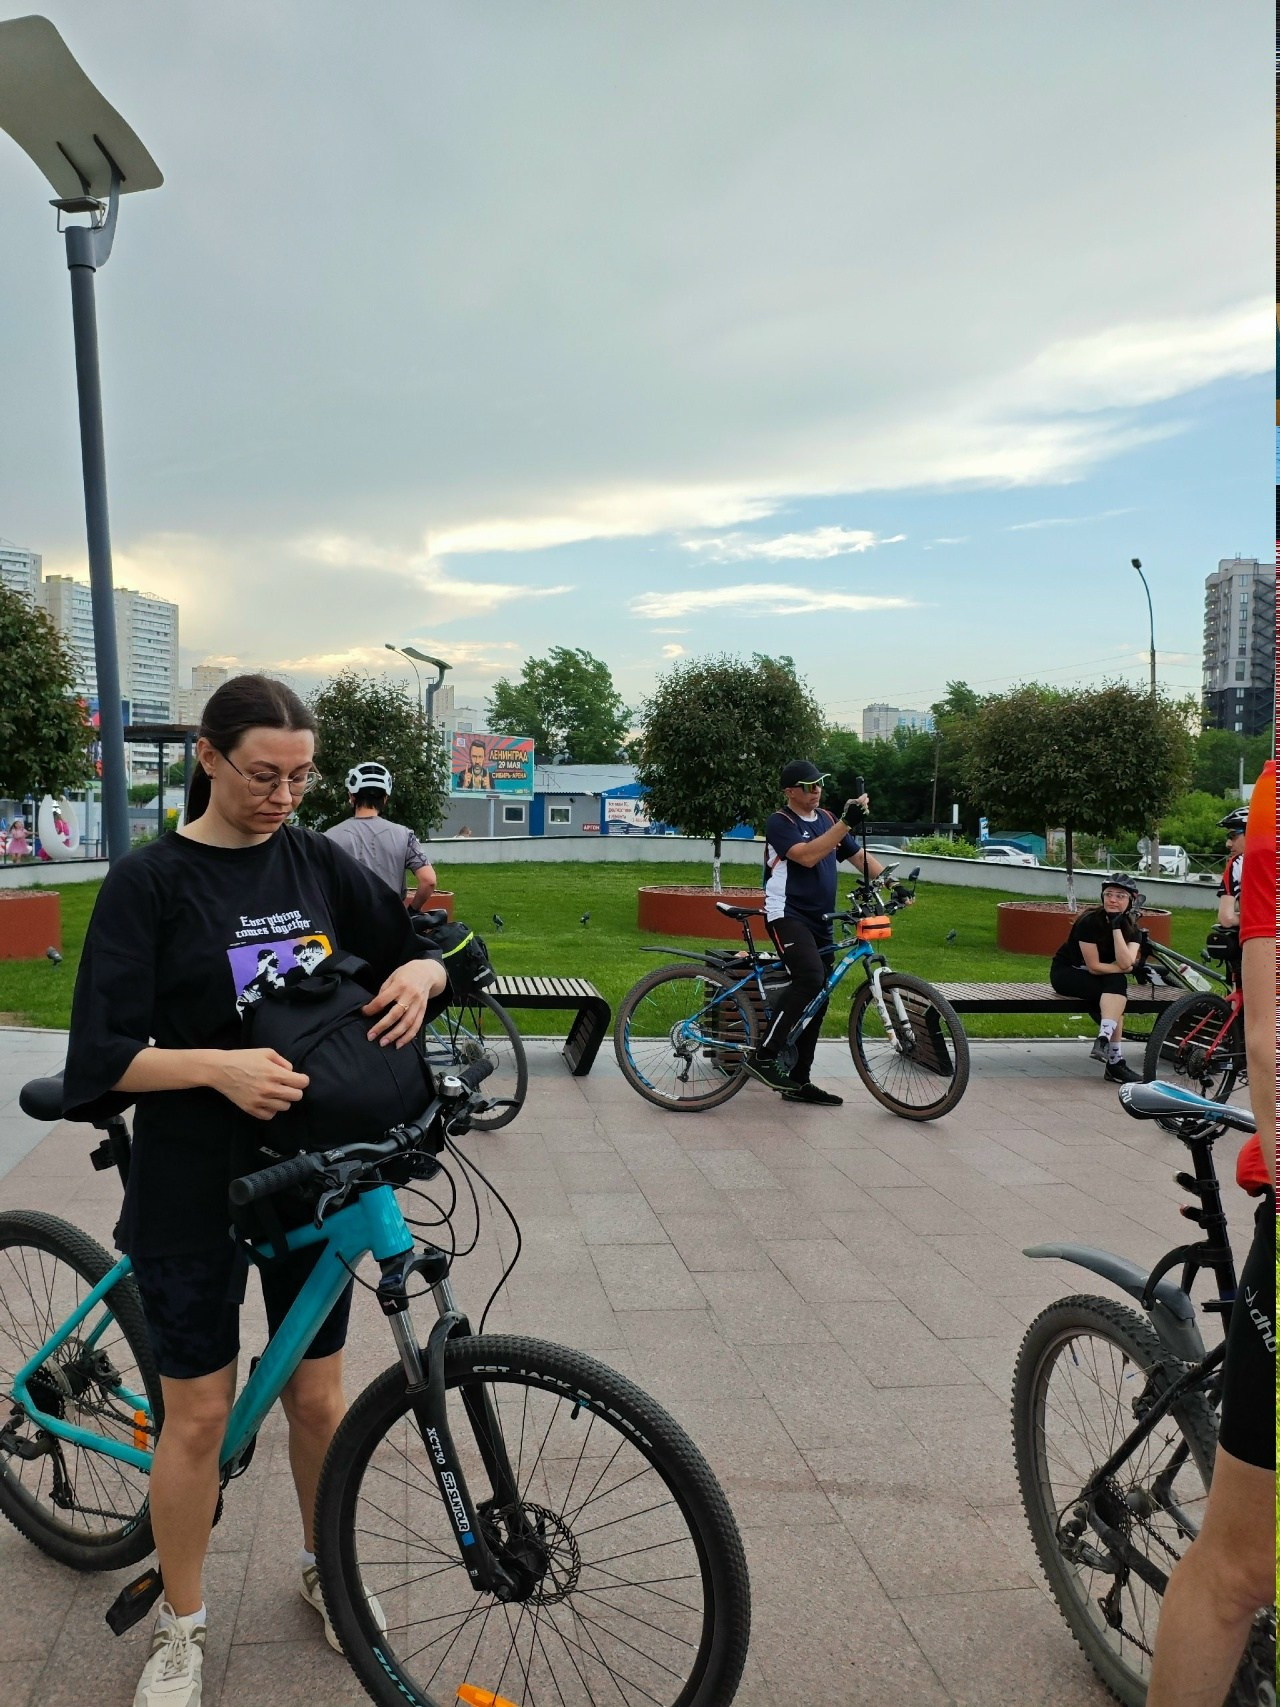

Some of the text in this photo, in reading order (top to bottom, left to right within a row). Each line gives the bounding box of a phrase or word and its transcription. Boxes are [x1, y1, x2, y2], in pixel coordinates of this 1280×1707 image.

[489, 750, 528, 762] ЛЕНИНГРАД
[498, 761, 521, 769] 29 МАЯ
[239, 910, 302, 927] Everything
[235, 927, 269, 938] comes
[372, 1647, 423, 1707] OUTL
